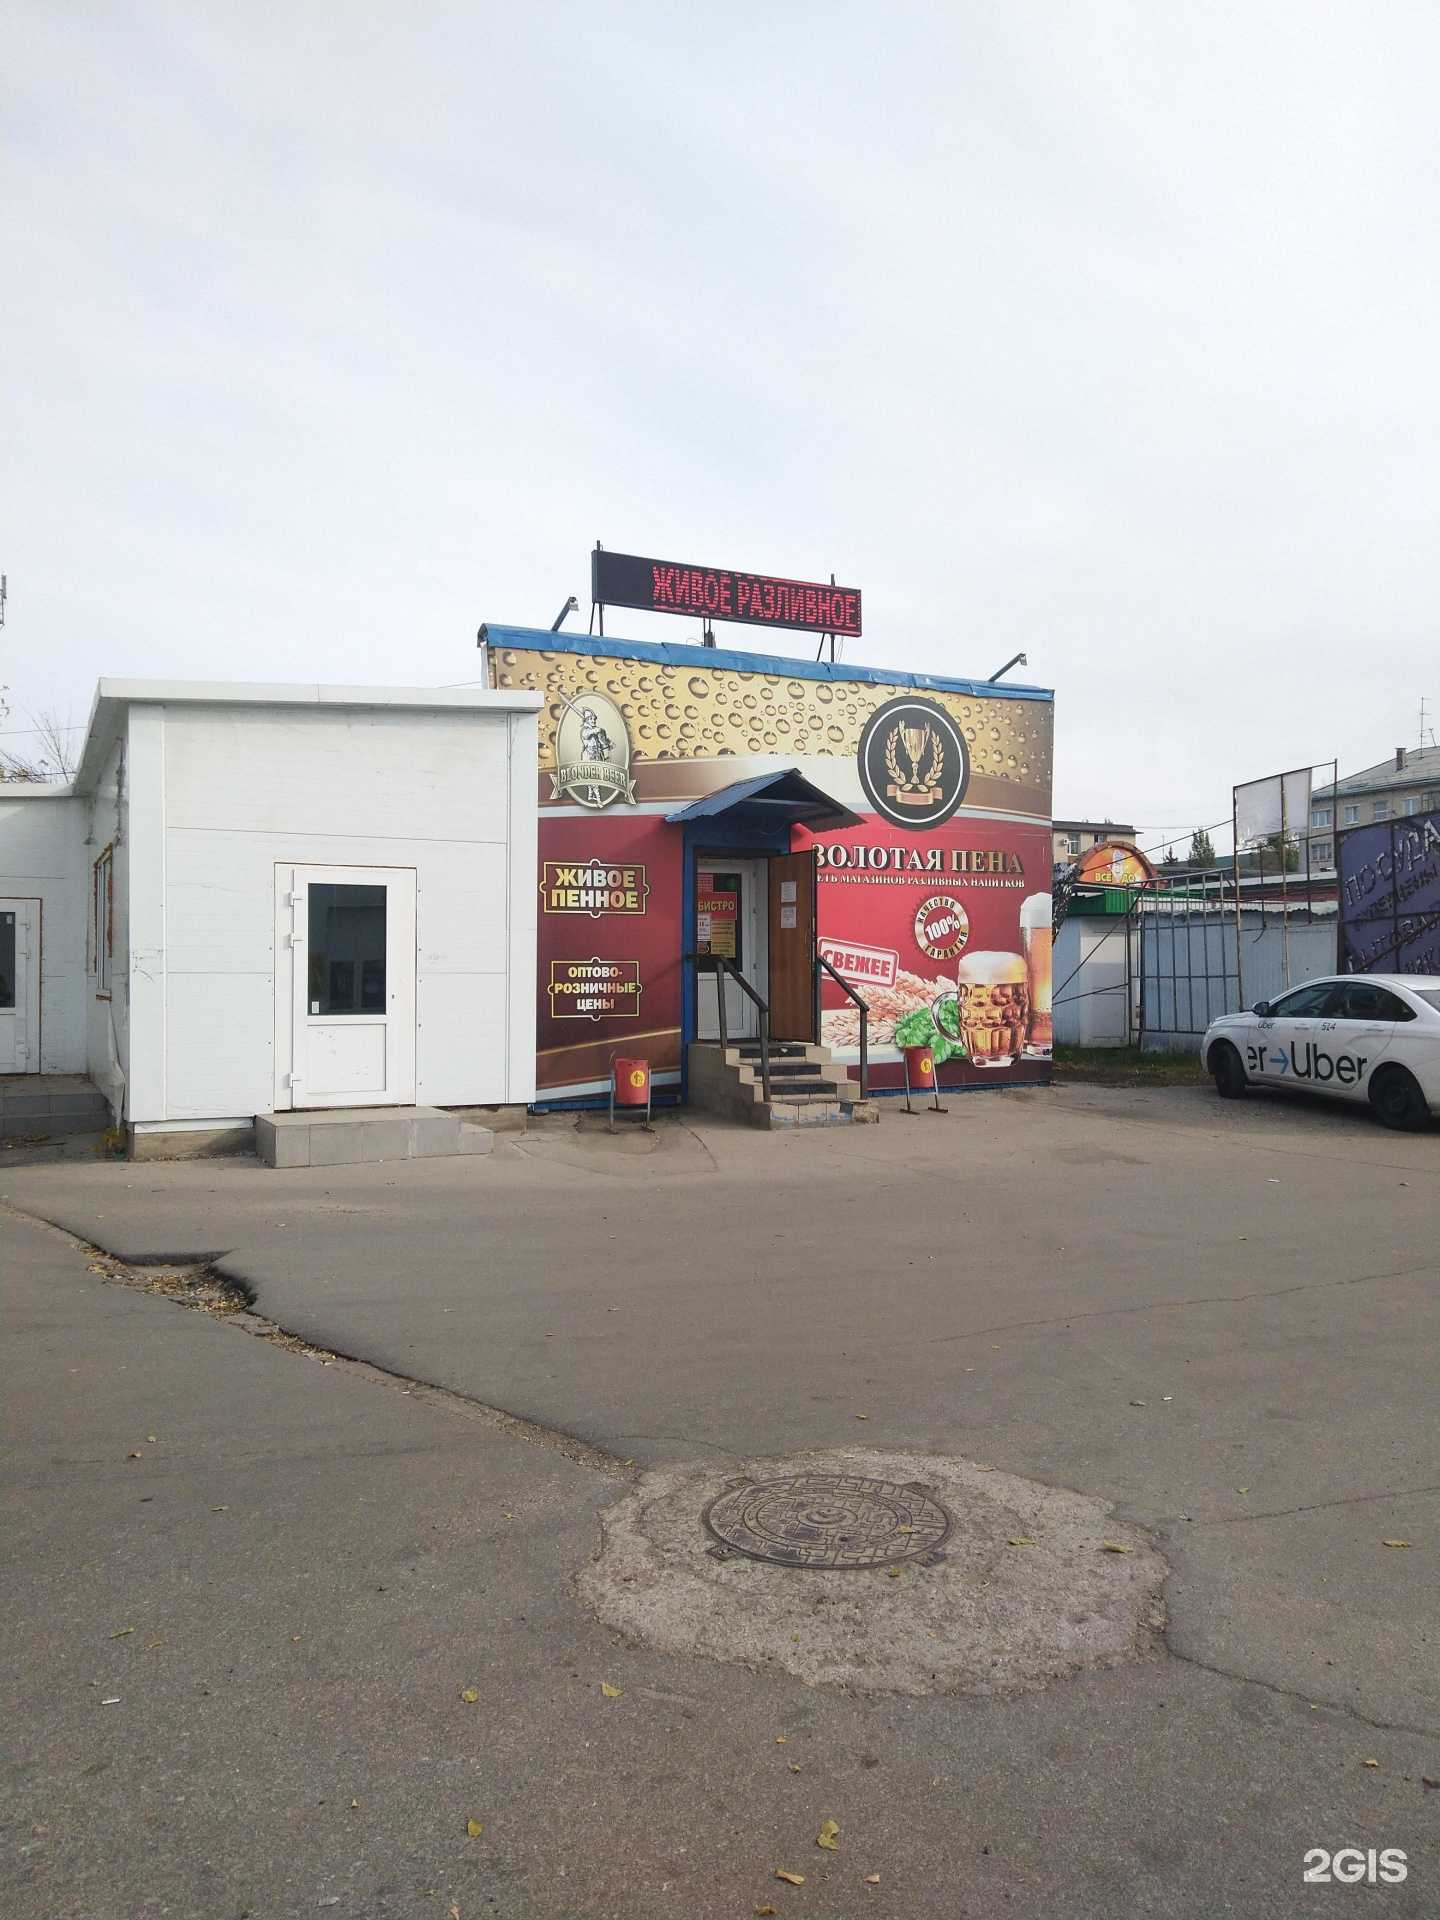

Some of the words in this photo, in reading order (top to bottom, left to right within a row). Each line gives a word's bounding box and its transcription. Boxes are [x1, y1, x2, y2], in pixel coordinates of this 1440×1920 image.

[653, 566, 733, 613] ЖИВОЕ
[737, 581, 857, 627] РАЗЛИВНОЕ
[560, 764, 602, 783] BLONDER
[603, 767, 626, 787] BEER
[814, 843, 942, 871] ЗОЛОТАЯ
[951, 850, 1024, 873] ПЕНА
[1344, 818, 1440, 906] ПОСУДА
[555, 868, 636, 888] ЖИВОЕ
[816, 873, 838, 883] ЕТЬ
[840, 875, 905, 885] МАГАЗИНОВ
[907, 877, 968, 888] РАЗЛИВНЫХ
[971, 878, 1025, 888] НАПИТКОВ
[551, 889, 639, 908] ПЕННОЕ
[698, 901, 735, 912] БИСТРО
[917, 898, 955, 923] КАЧЕСТВО
[925, 914, 960, 940] 100%
[925, 931, 967, 958] ГАРАНТИЯ
[568, 967, 623, 978] ОПТОВО-
[822, 950, 891, 977] СВЕЖЕЕ
[555, 983, 636, 994] РОЗНИЧНЫЕ
[577, 999, 614, 1011] ЦЕНЫ
[1291, 1041, 1368, 1083] Uber
